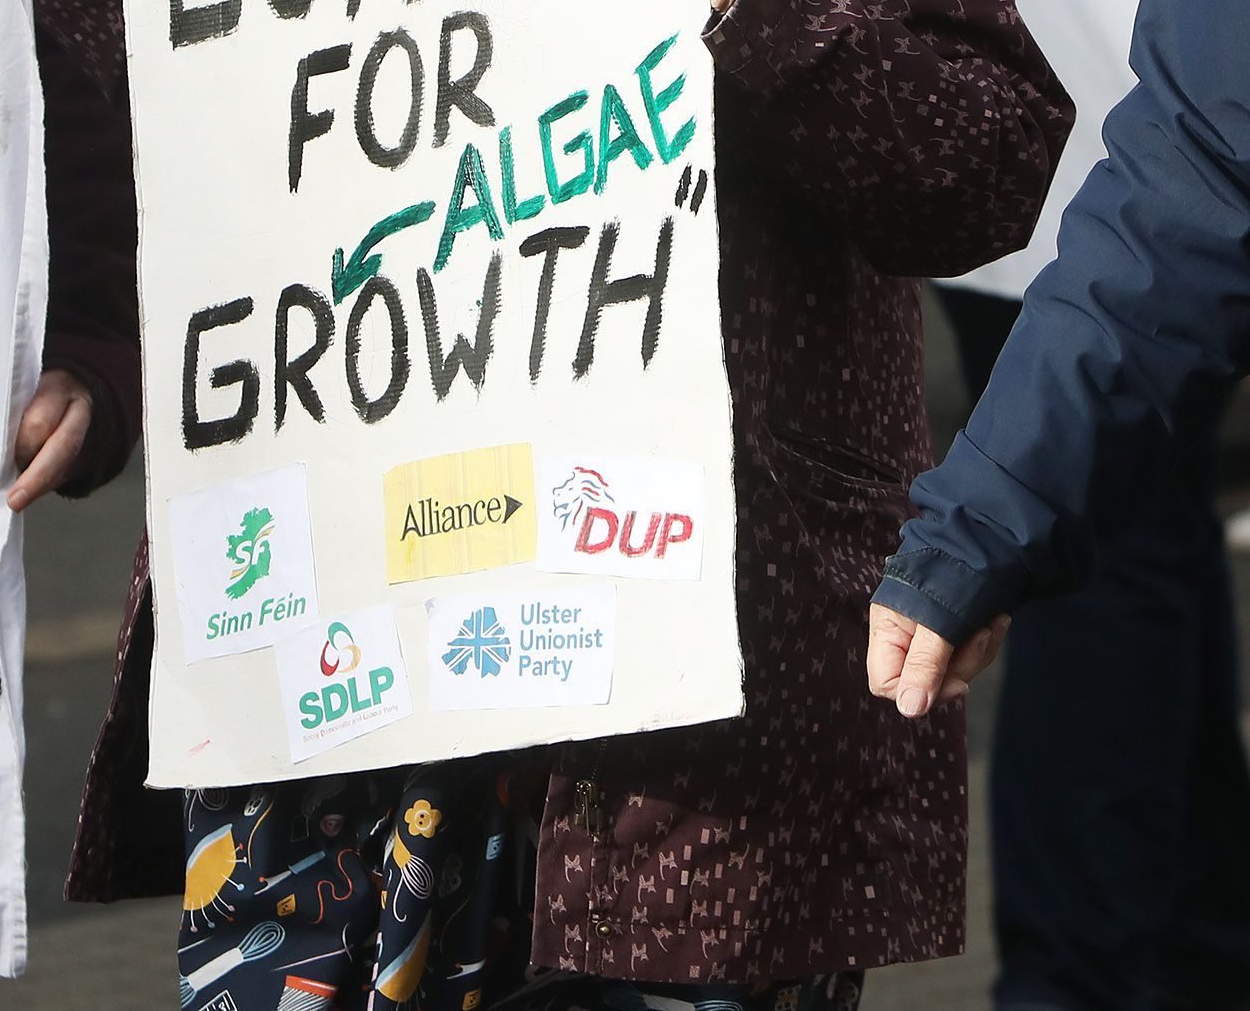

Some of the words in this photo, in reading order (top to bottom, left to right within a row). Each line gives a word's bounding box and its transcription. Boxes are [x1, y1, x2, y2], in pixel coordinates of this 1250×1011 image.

[288, 9, 495, 194] FOR
[432, 31, 697, 273] ALGAE
[180, 165, 708, 451] GROWTH"
[400, 495, 502, 541] Alliance
[573, 506, 694, 559] DUP
[235, 536, 269, 567] SF
[206, 611, 252, 640] Sinn
[258, 592, 306, 626] Féin
[520, 602, 582, 625] Ulster
[519, 628, 603, 651] Unionist
[518, 655, 573, 681] Party
[299, 666, 394, 729] SDLP
